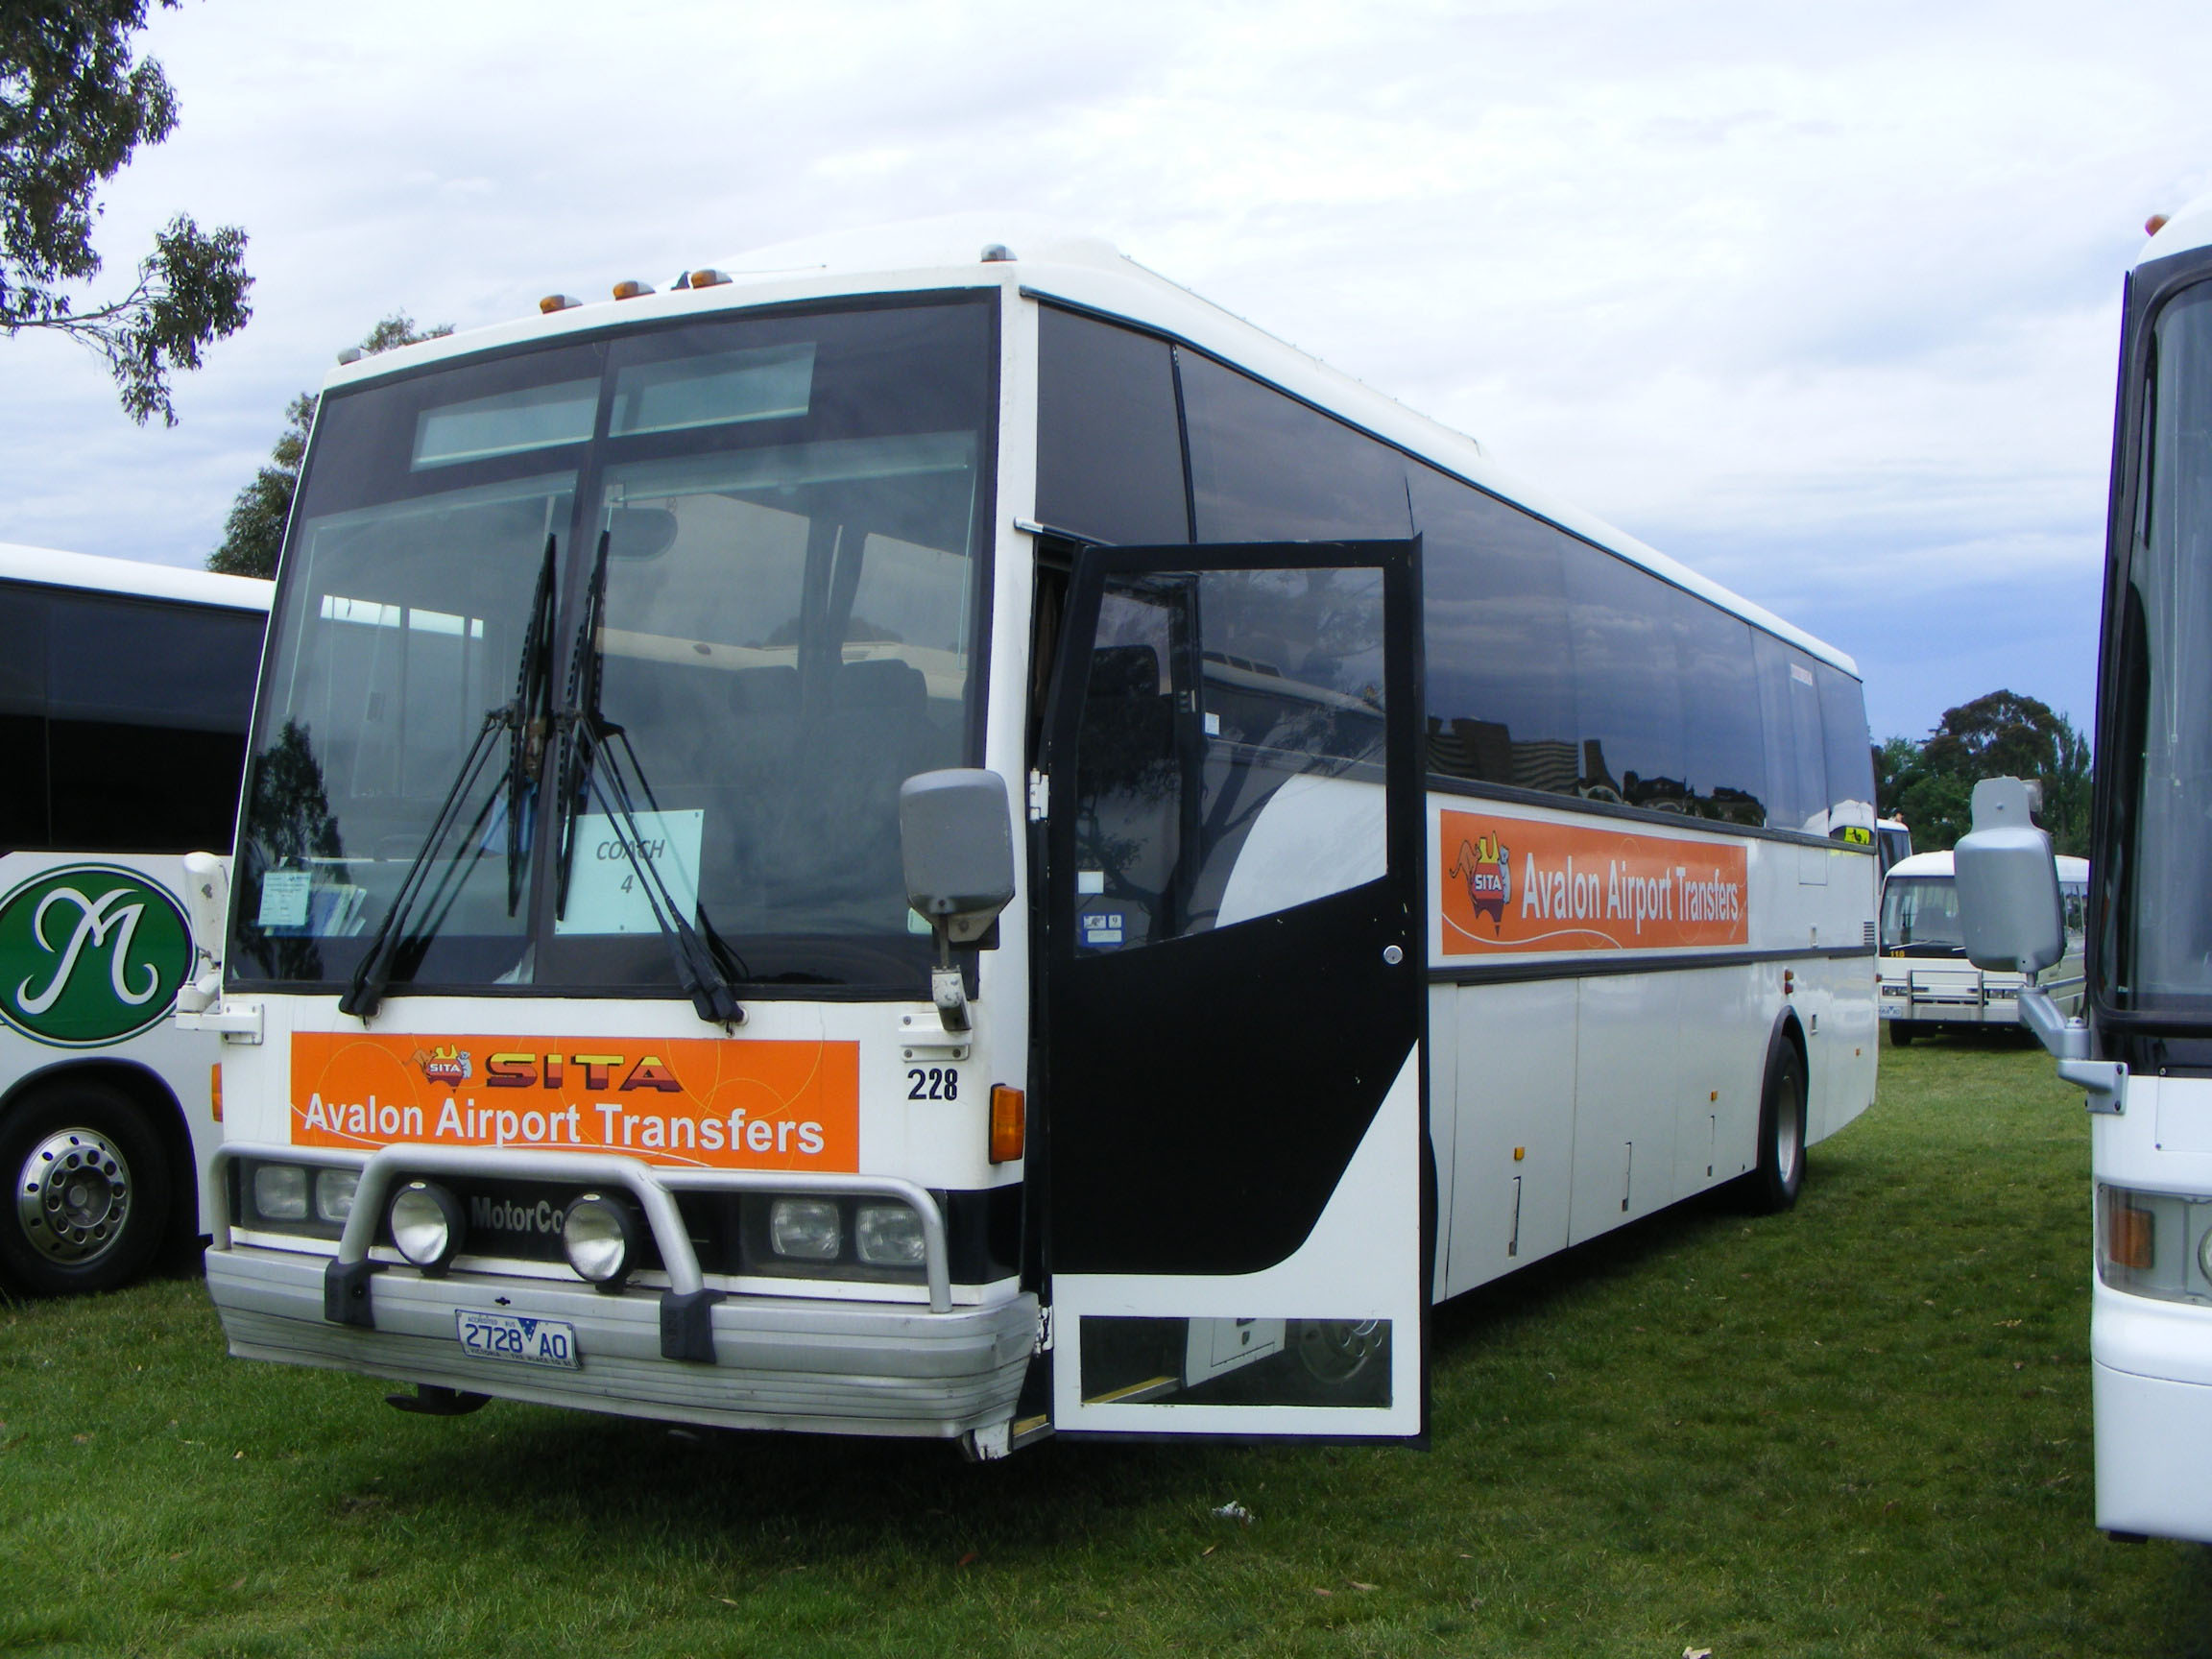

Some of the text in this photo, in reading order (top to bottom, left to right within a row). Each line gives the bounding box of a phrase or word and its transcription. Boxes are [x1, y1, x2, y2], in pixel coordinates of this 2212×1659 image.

[596, 838, 665, 860] COACH
[620, 874, 634, 894] 4
[1473, 872, 1503, 892] SITA
[1521, 852, 1739, 935] Avalon Airport Transfers
[429, 1063, 462, 1073] SITA
[486, 1052, 683, 1094] SITA
[907, 1068, 958, 1101] 228
[304, 1093, 825, 1154] Avalon Airport Transfers
[465, 1323, 523, 1354] 2728
